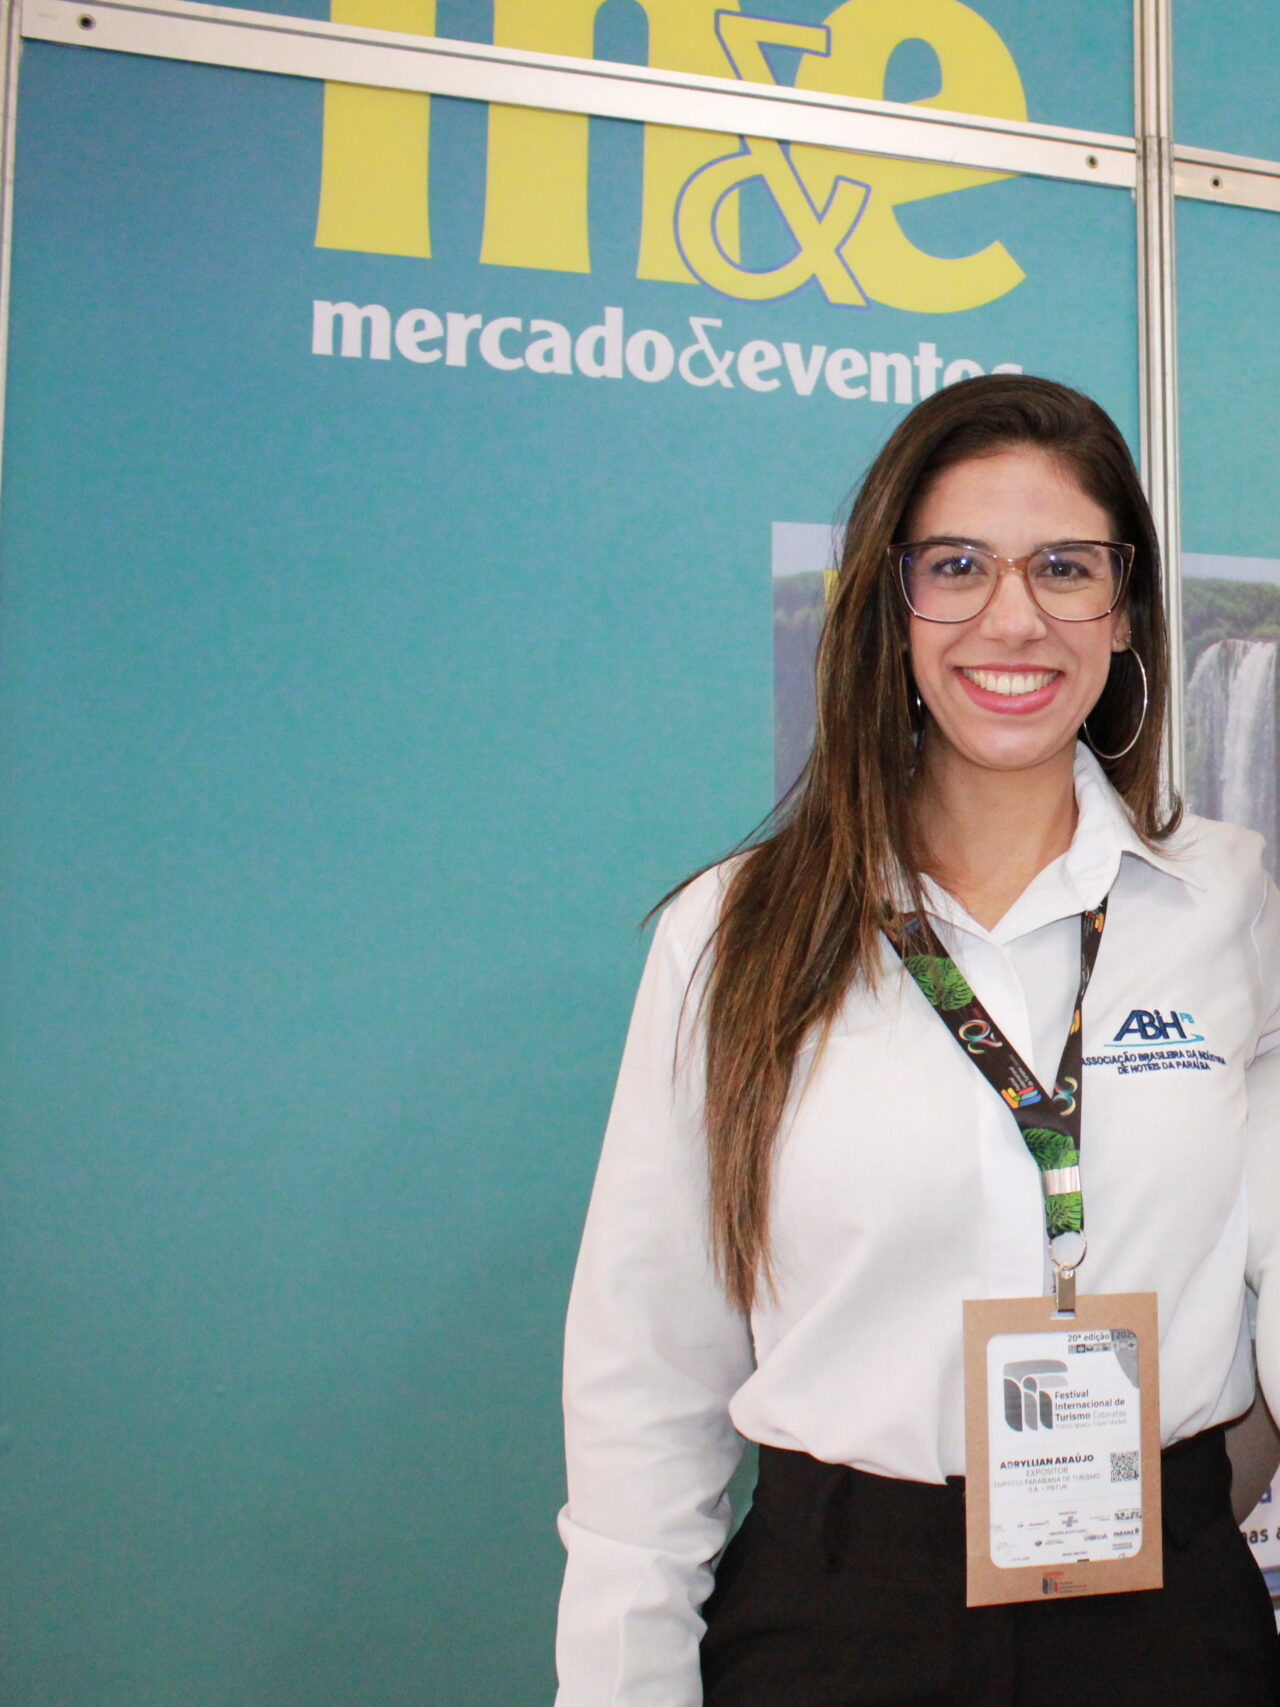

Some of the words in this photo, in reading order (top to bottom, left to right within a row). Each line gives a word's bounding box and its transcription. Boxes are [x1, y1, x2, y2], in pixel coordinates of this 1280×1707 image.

[1162, 1062, 1174, 1070] DA
[1084, 1331, 1110, 1342] edição
[1055, 1389, 1089, 1399] Festival
[1055, 1398, 1112, 1410] Internacional
[1114, 1397, 1125, 1406] de
[1055, 1411, 1091, 1422] Turismo
[1000, 1457, 1053, 1470] ADRYLLIAN
[1055, 1452, 1094, 1465] ARAÚJO
[1026, 1466, 1069, 1477] EXPOSITOR
